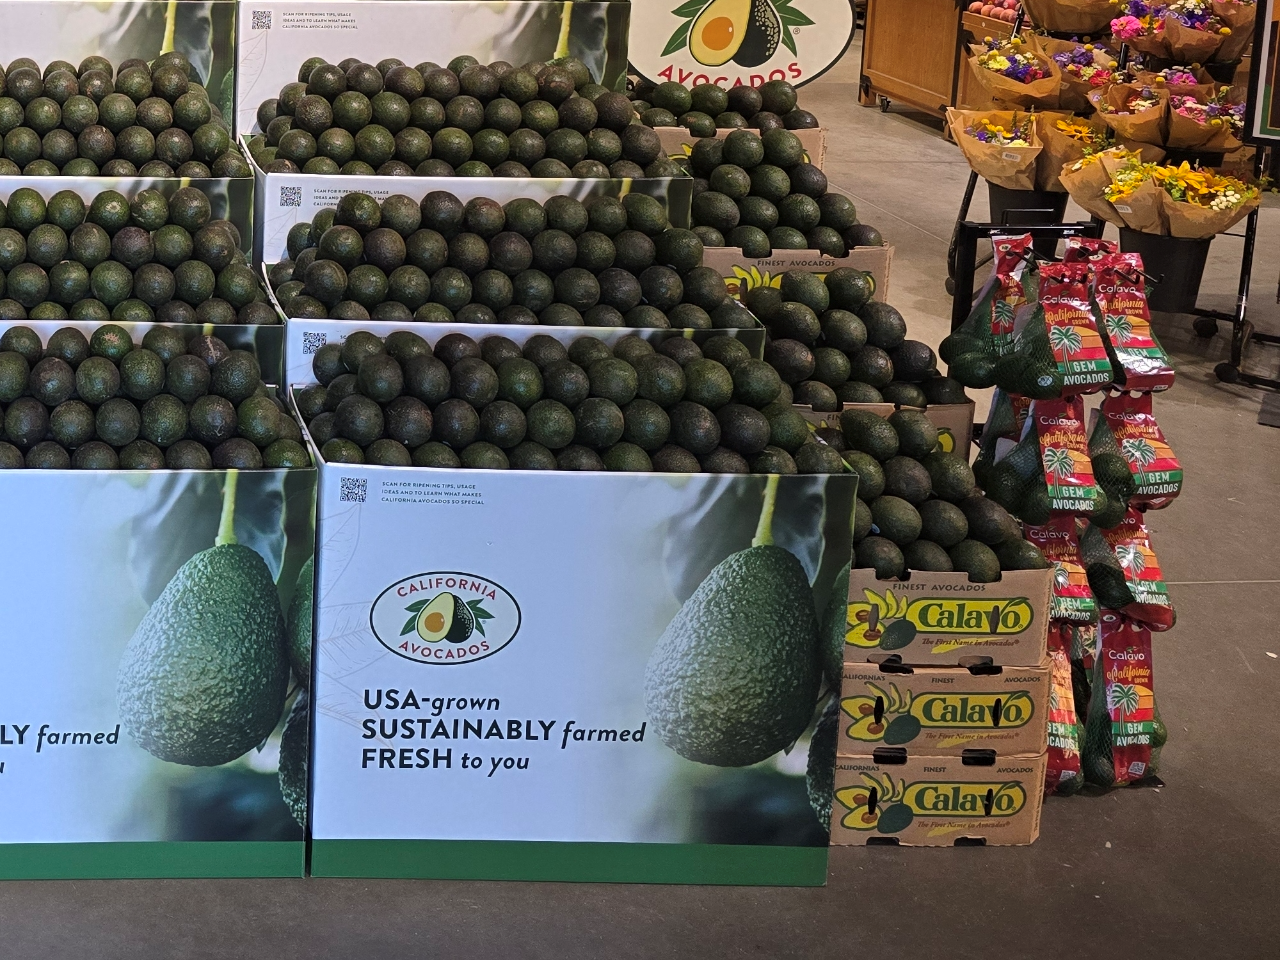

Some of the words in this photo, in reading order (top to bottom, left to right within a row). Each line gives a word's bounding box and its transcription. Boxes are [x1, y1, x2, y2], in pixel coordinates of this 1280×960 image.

[1064, 373, 1109, 385] AVOCADOS
[1073, 362, 1096, 372] GEM
[396, 577, 496, 601] CALIFORNIA
[399, 640, 490, 660] AVOCADOS
[363, 688, 500, 716] USA-grown
[36, 724, 119, 752] farmed
[361, 719, 556, 741] SUSTAINABLY
[562, 722, 647, 749] farmed
[361, 747, 452, 769] FRESH
[461, 751, 482, 769] to
[488, 755, 529, 776] you
